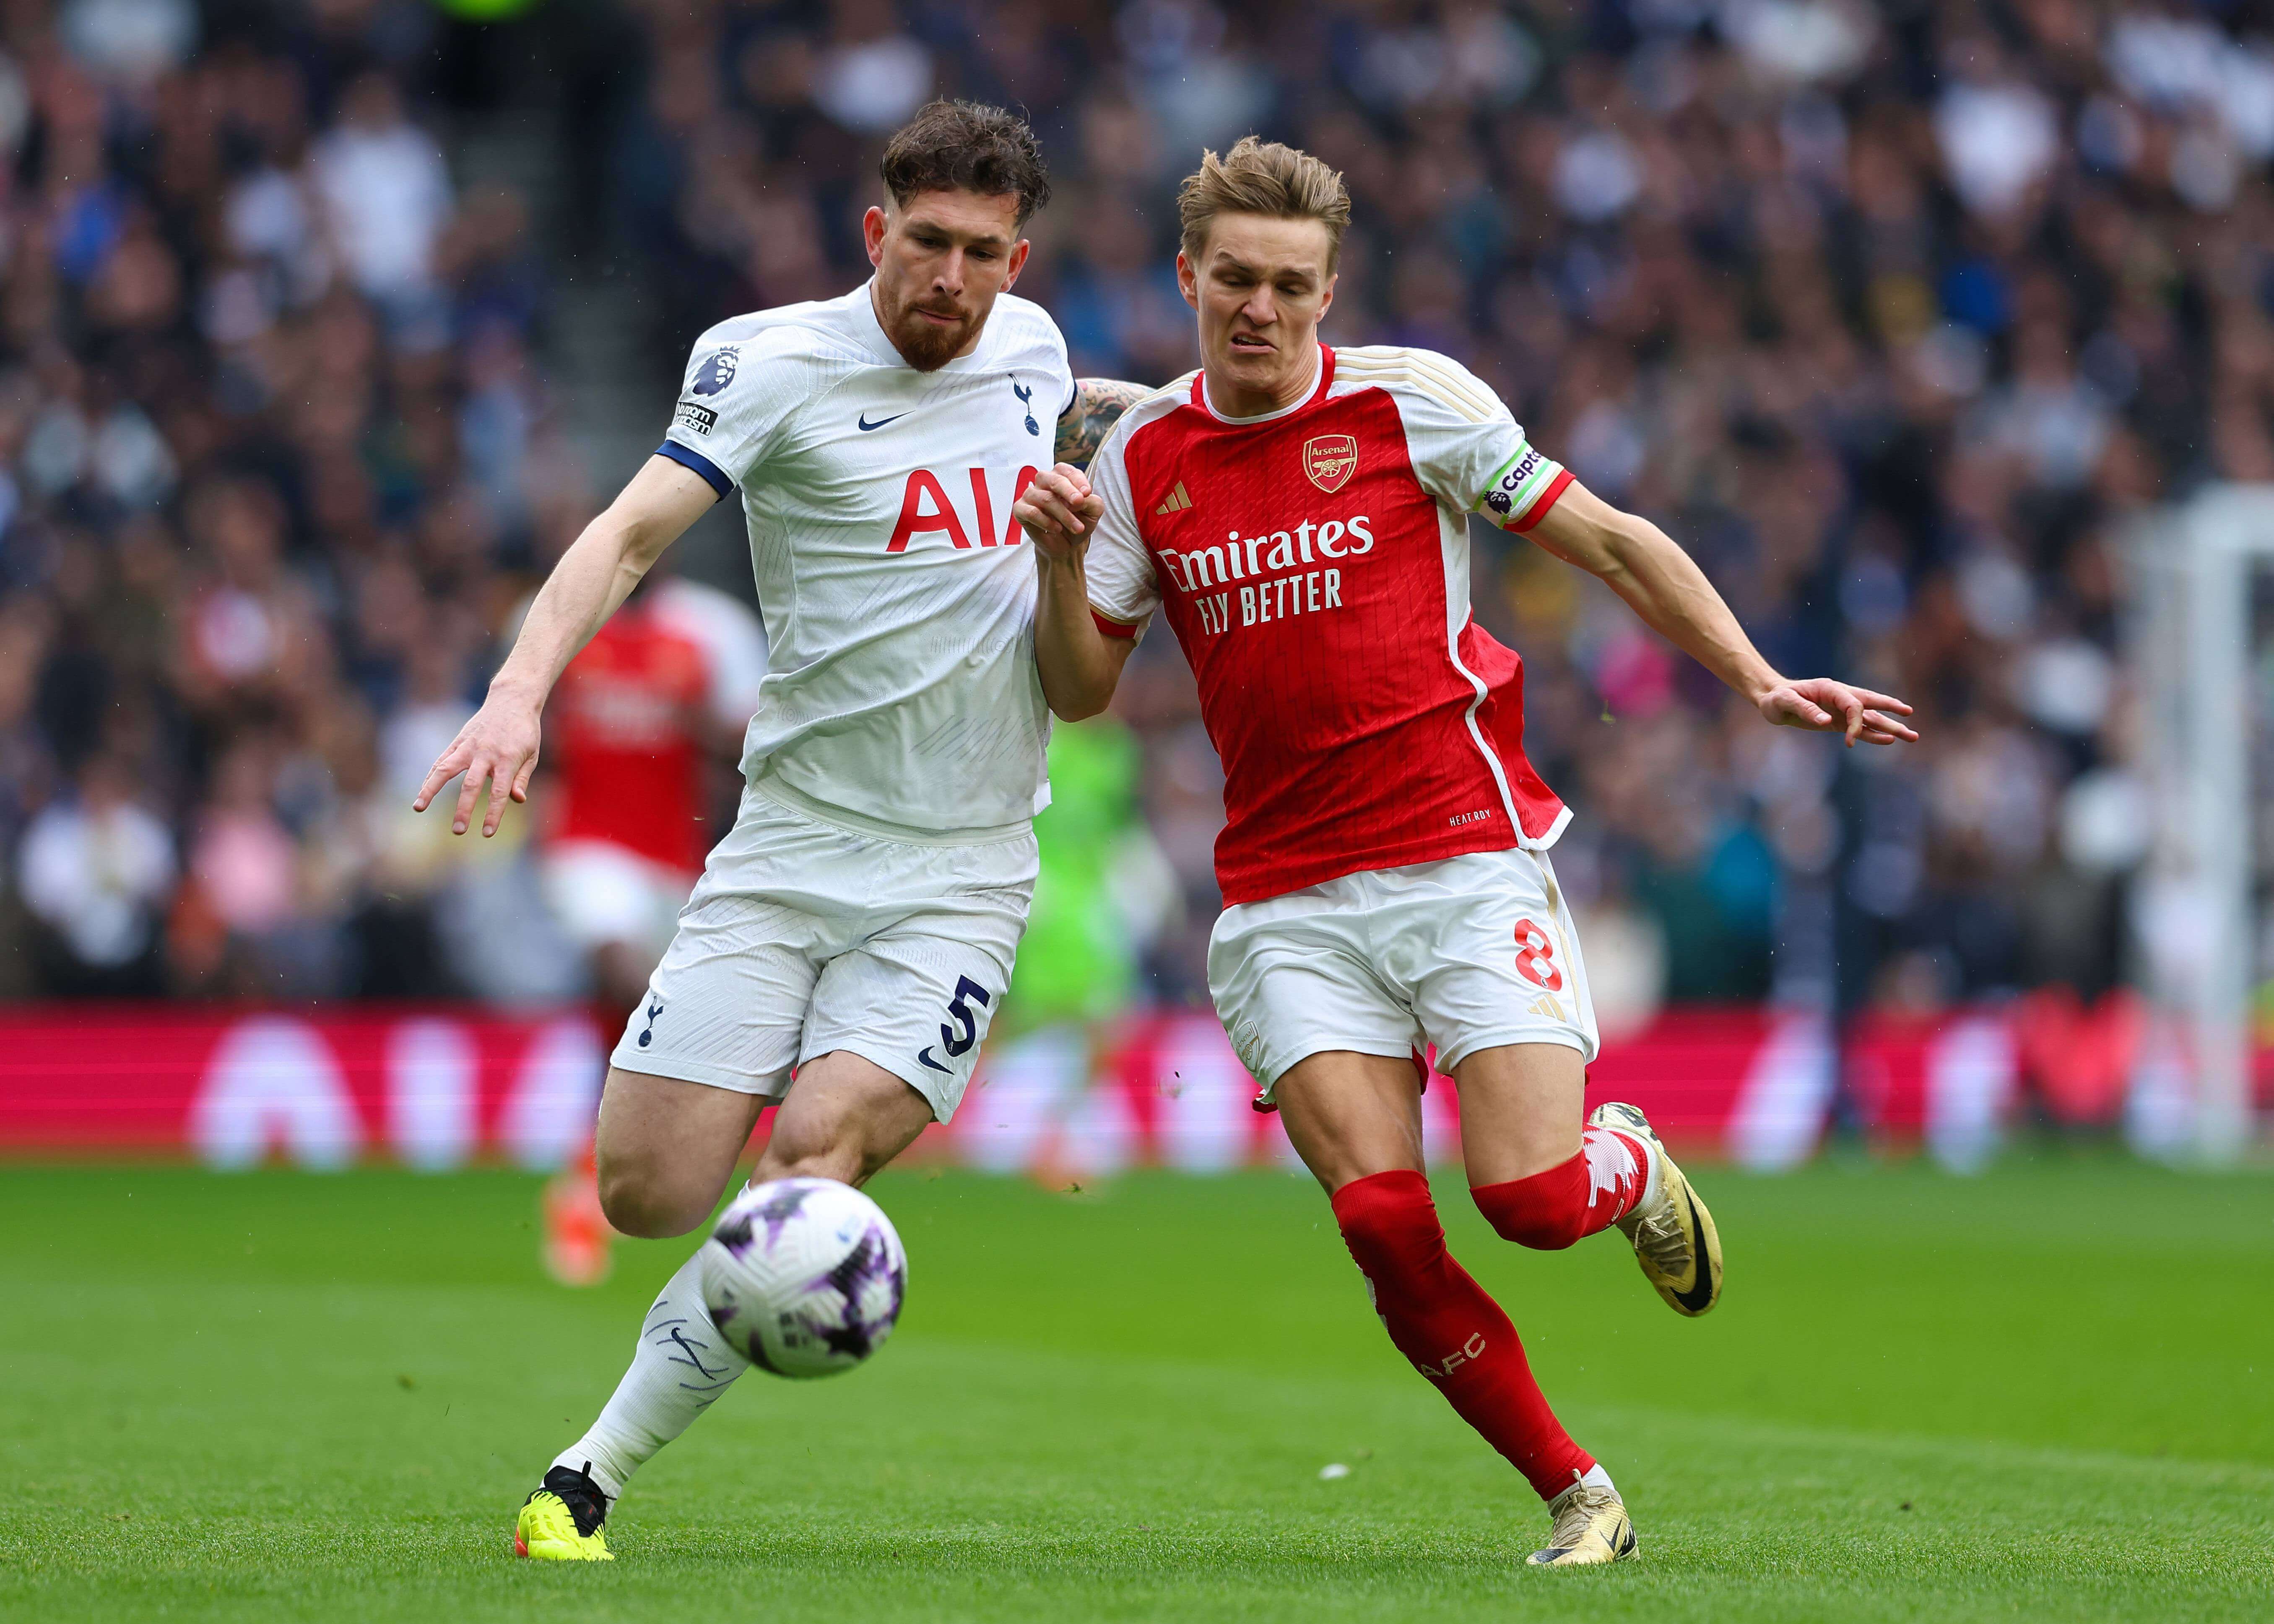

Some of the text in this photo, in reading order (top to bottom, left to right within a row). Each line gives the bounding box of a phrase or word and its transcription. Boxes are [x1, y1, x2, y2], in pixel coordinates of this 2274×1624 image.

[683, 405, 710, 423] room
[1311, 444, 1349, 457] Arsenal
[1156, 516, 1374, 592] Emirates
[1195, 568, 1343, 635] FLY BETTER
[1514, 919, 1562, 991] 8
[941, 975, 990, 1057] 5
[1421, 1332, 1486, 1377] AFC
